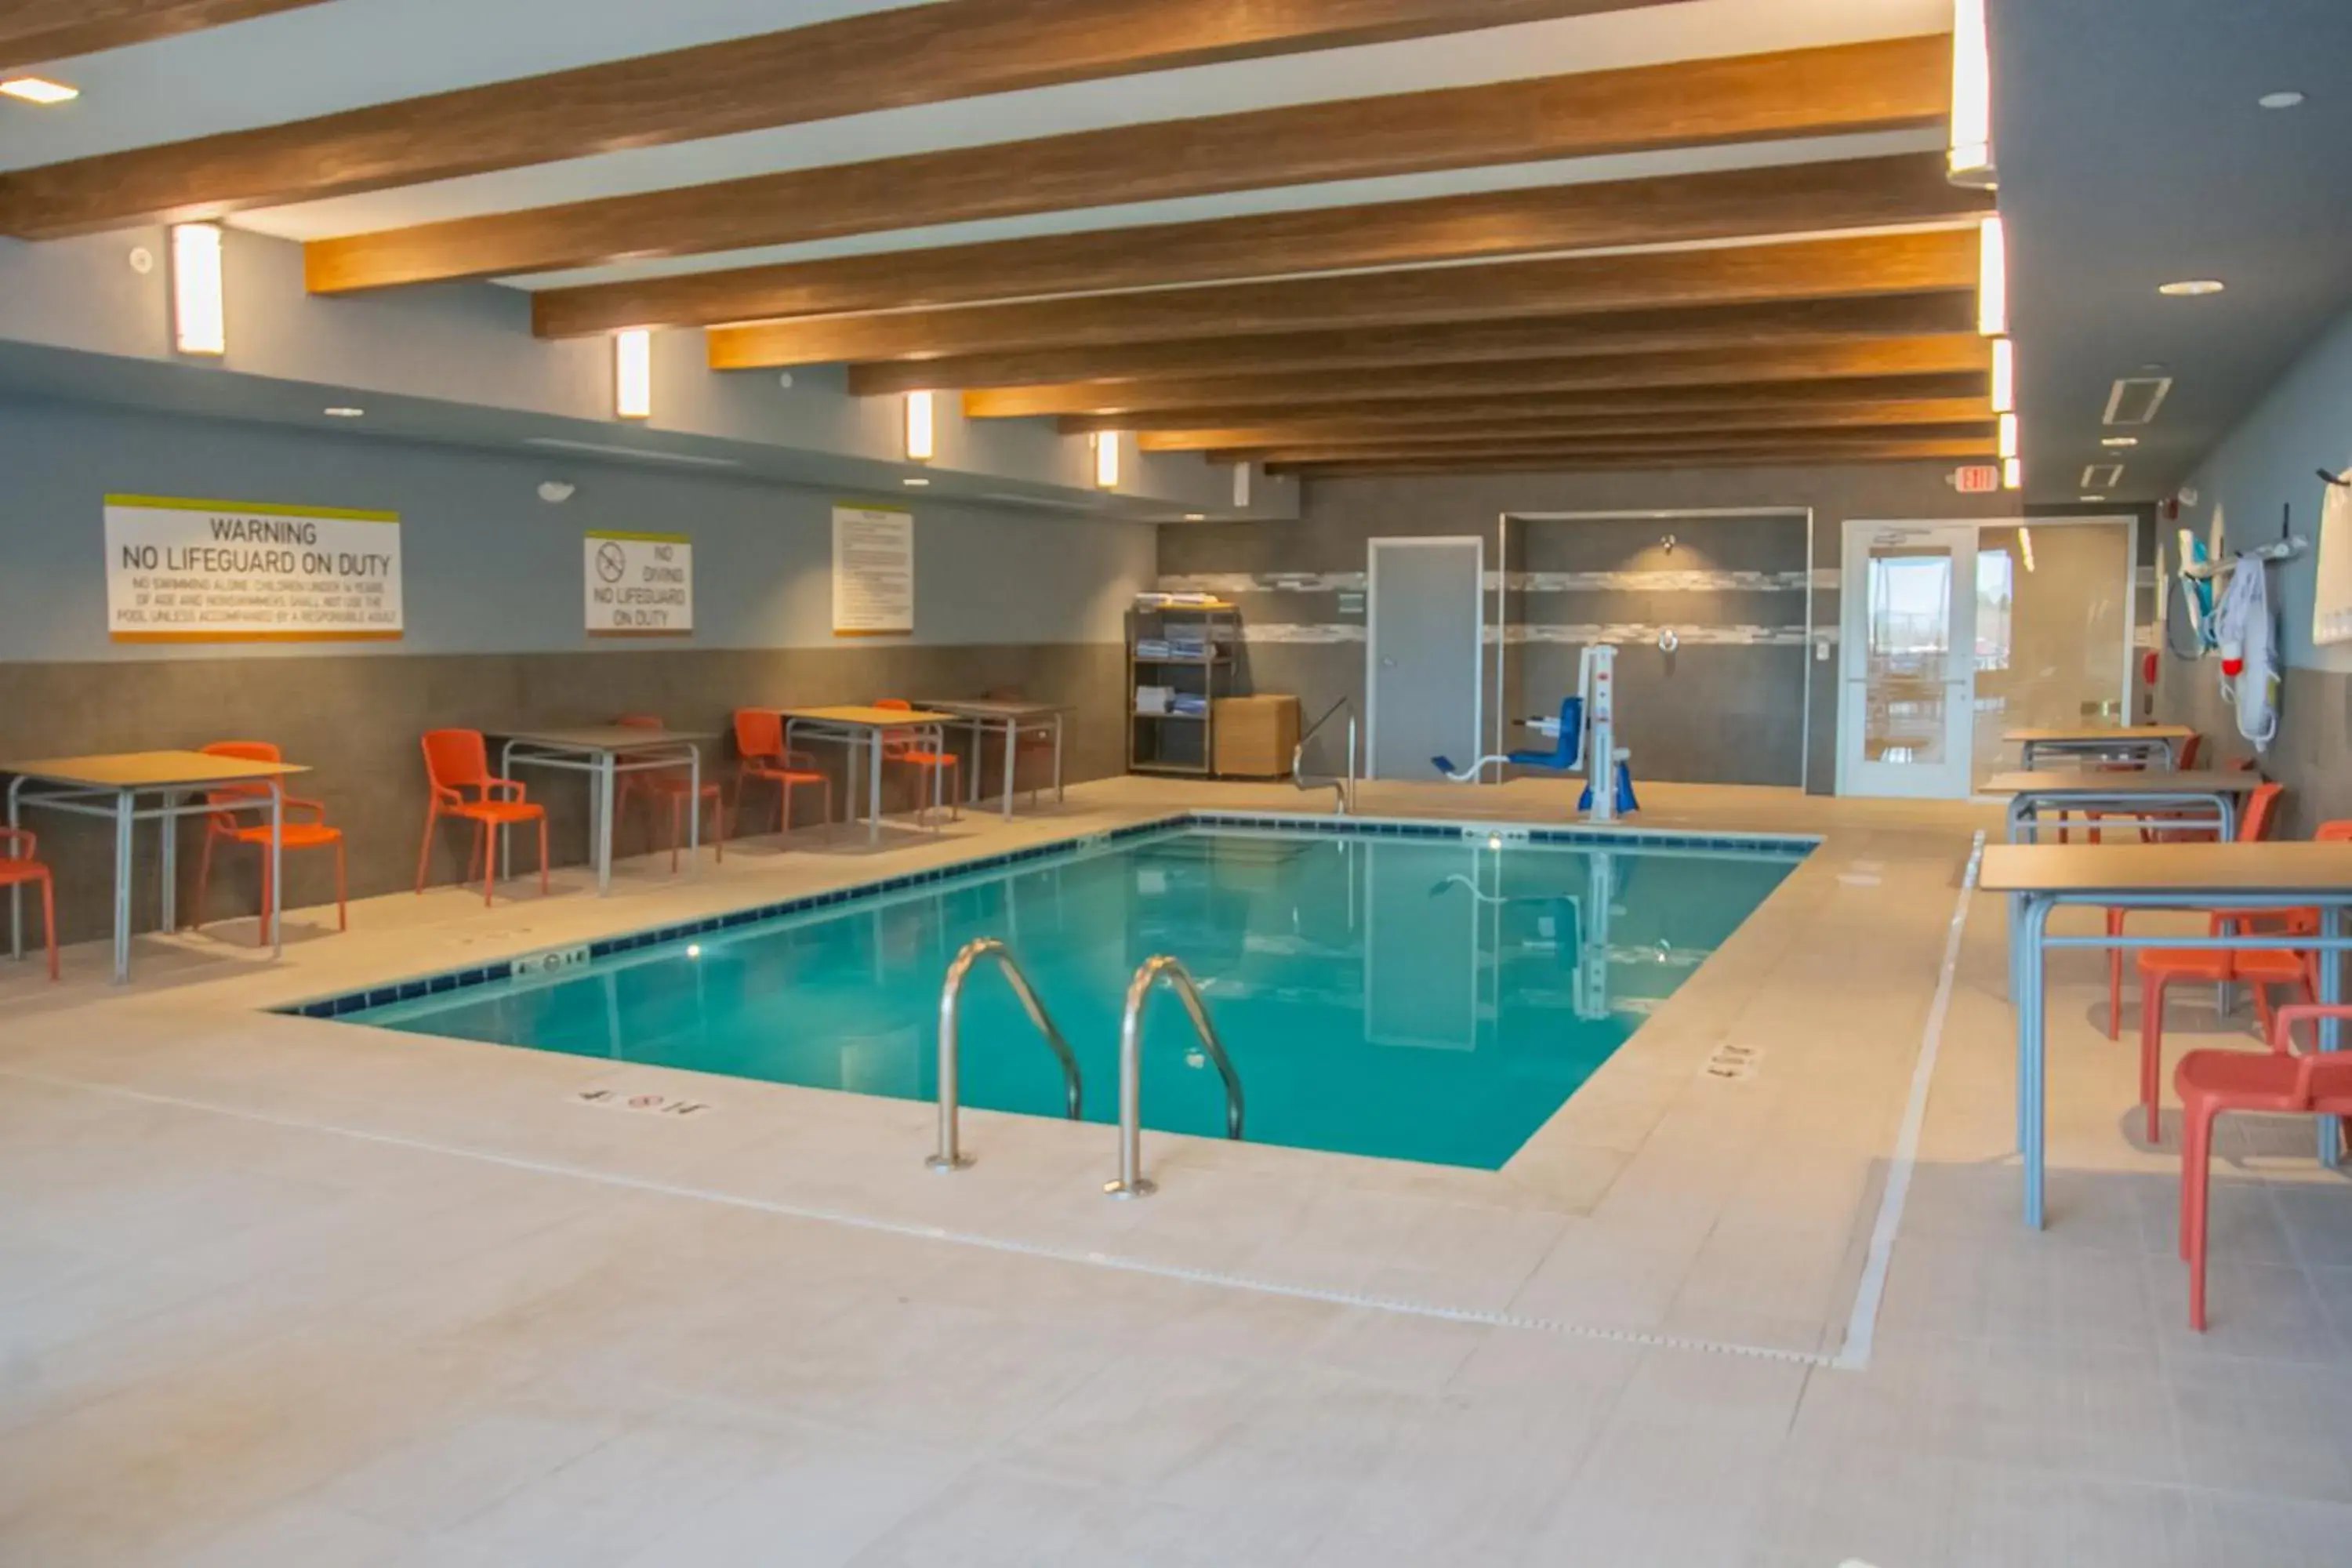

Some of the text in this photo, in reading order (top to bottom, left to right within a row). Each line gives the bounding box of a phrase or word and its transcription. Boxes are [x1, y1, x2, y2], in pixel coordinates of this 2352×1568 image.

[210, 518, 317, 545] WARNING
[123, 543, 390, 576] NO LIFEGUARD ON DUTY
[655, 545, 674, 561] NO
[593, 587, 685, 605] NO LIFEGUARD
[613, 609, 669, 626] ON DUTY
